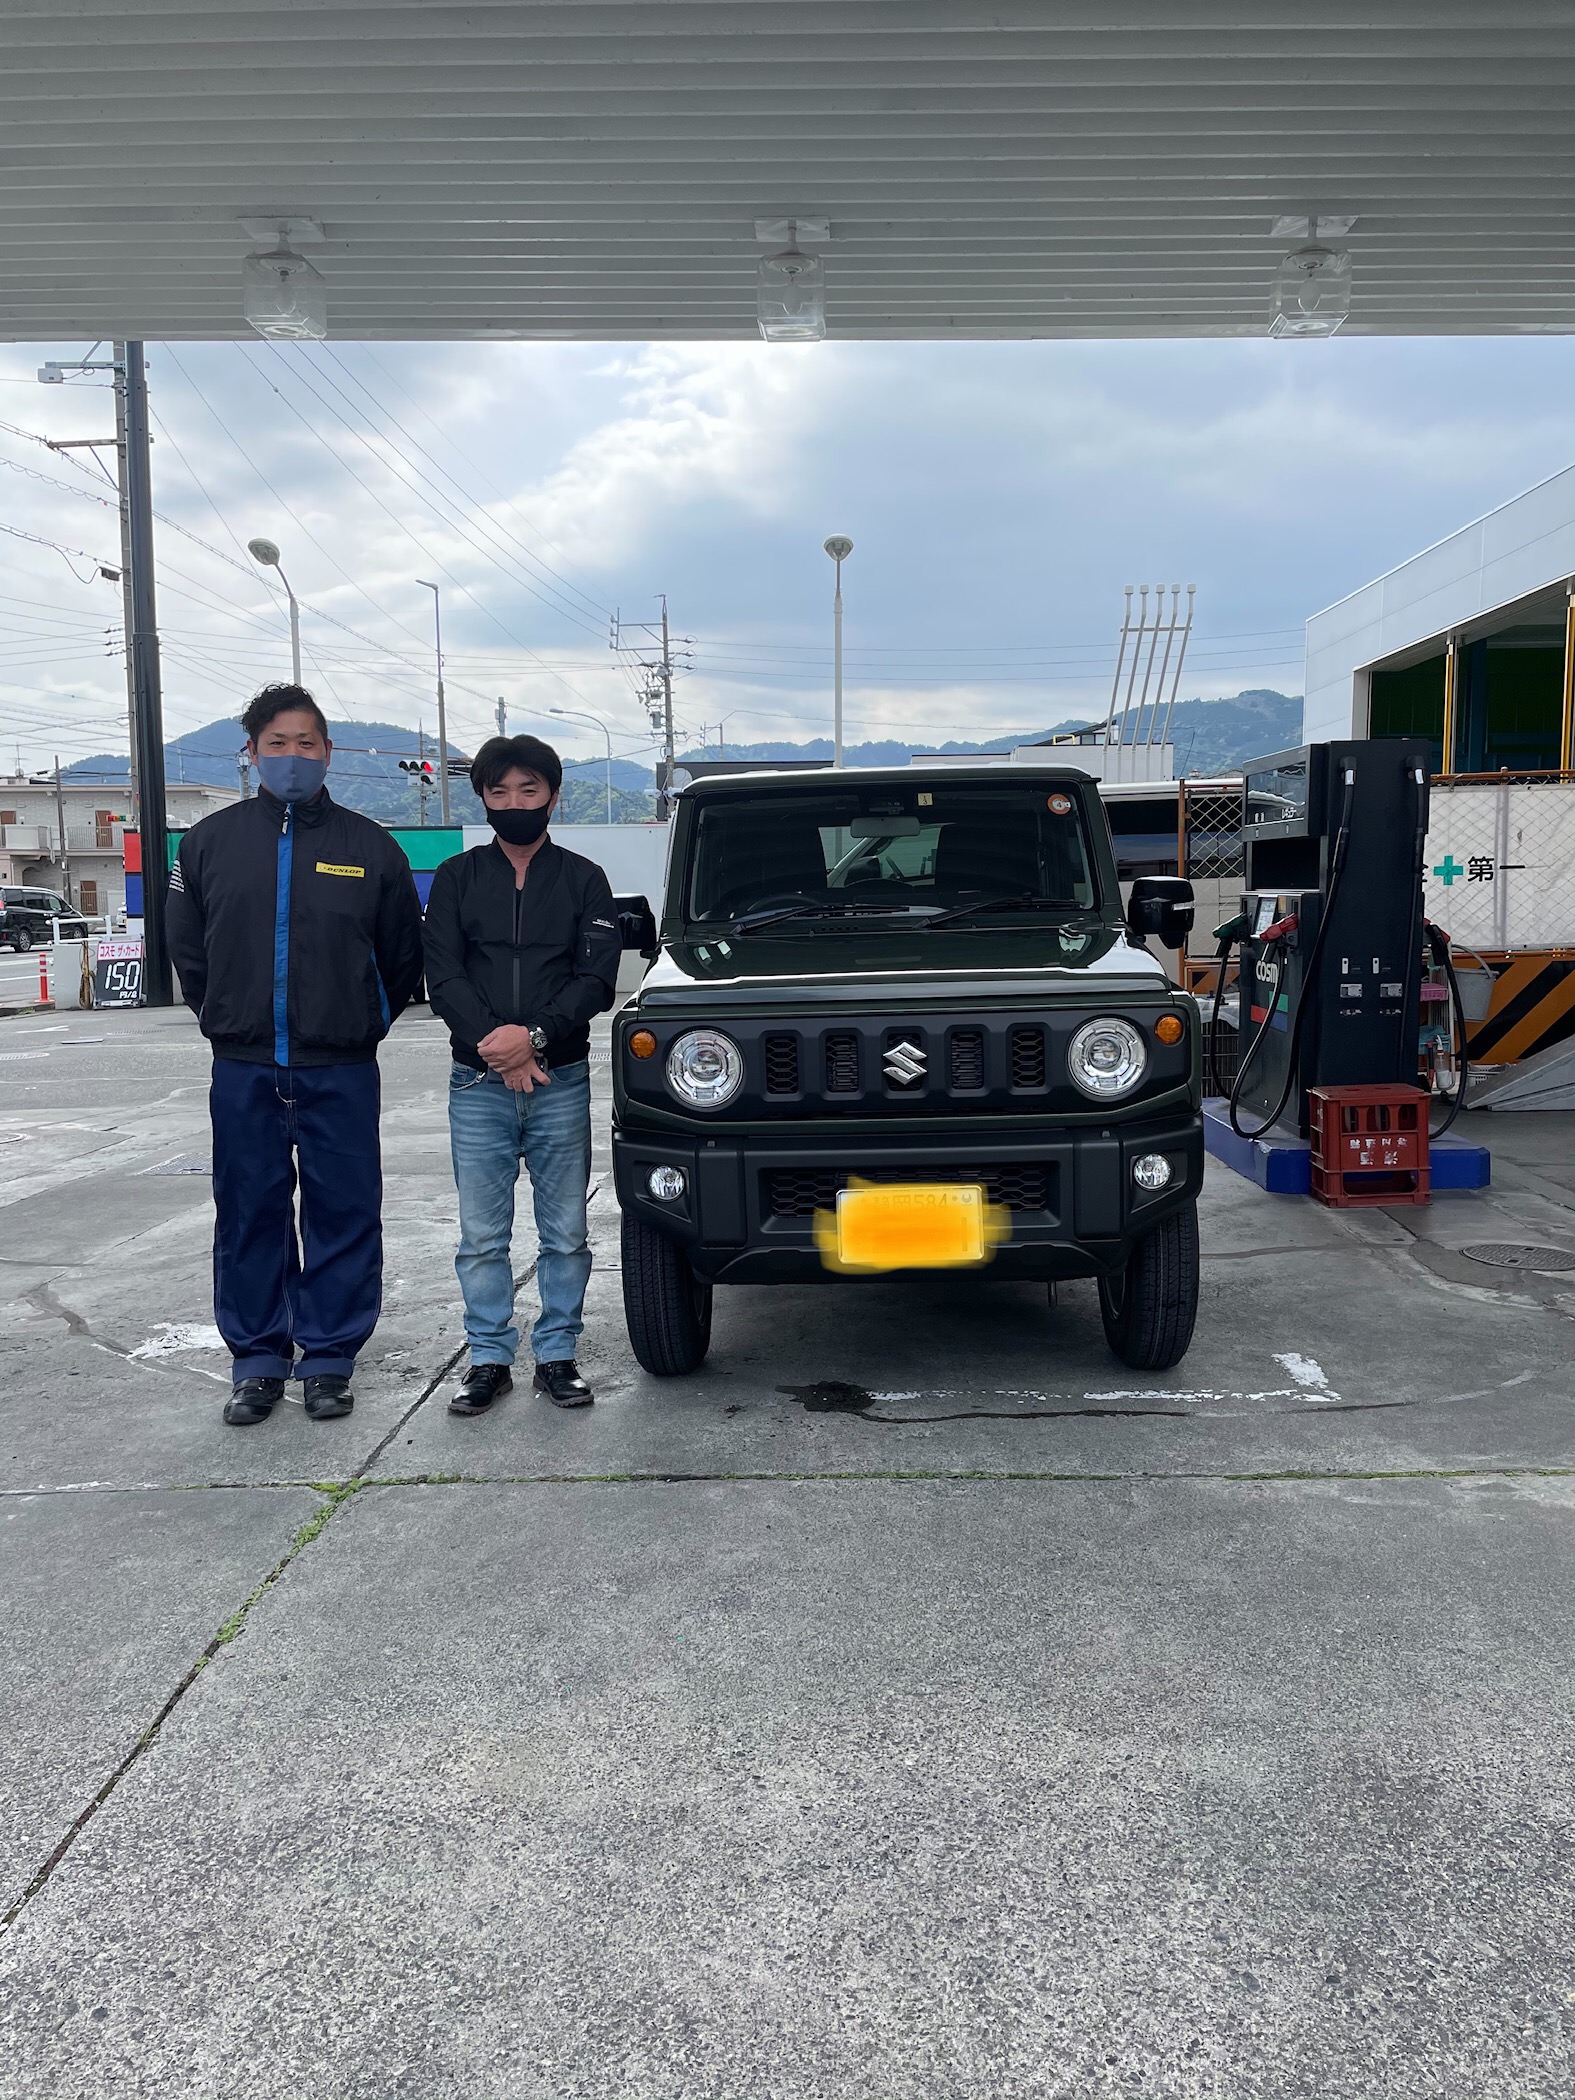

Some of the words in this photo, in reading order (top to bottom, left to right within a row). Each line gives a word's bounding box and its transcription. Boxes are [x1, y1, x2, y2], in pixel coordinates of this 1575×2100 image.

[1467, 855, 1526, 883] 第一
[100, 946, 116, 957] コスモ
[105, 961, 141, 990] 150
